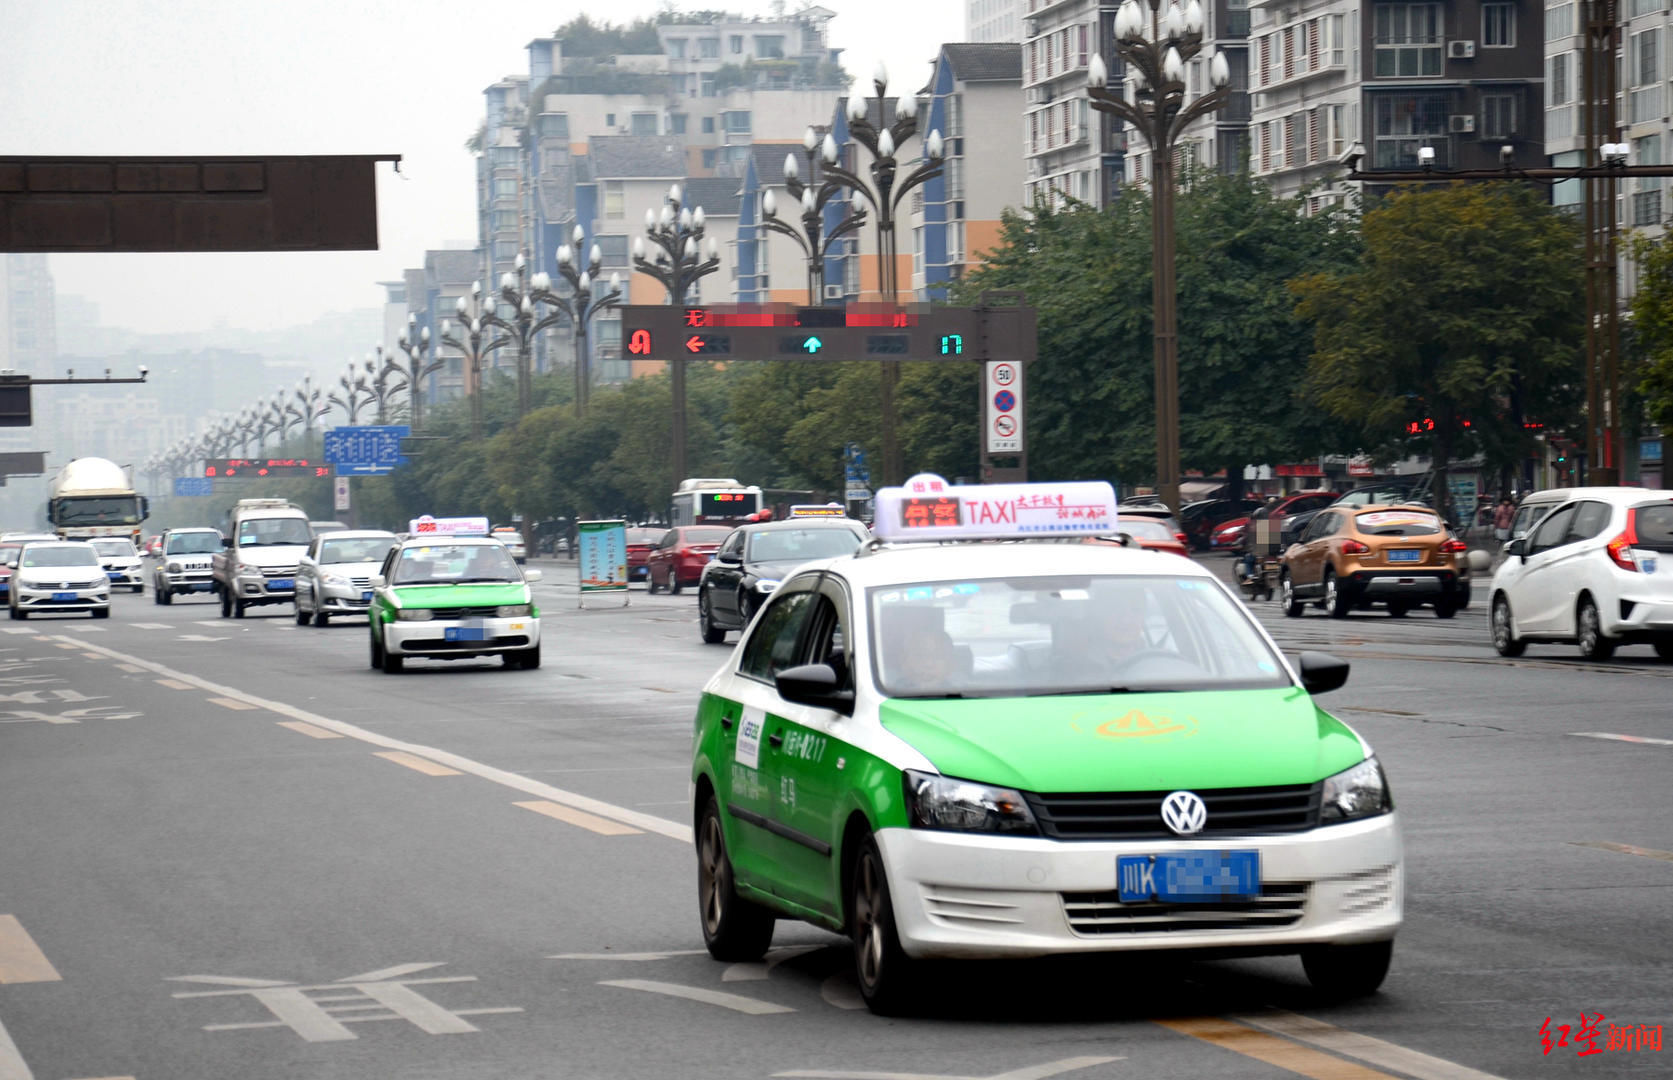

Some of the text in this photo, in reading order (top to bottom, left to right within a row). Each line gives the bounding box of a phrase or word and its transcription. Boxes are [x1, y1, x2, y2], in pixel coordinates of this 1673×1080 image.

[941, 334, 962, 355] 17
[998, 369, 1011, 380] 50
[912, 481, 944, 493] 出租
[965, 501, 1017, 525] TAXI
